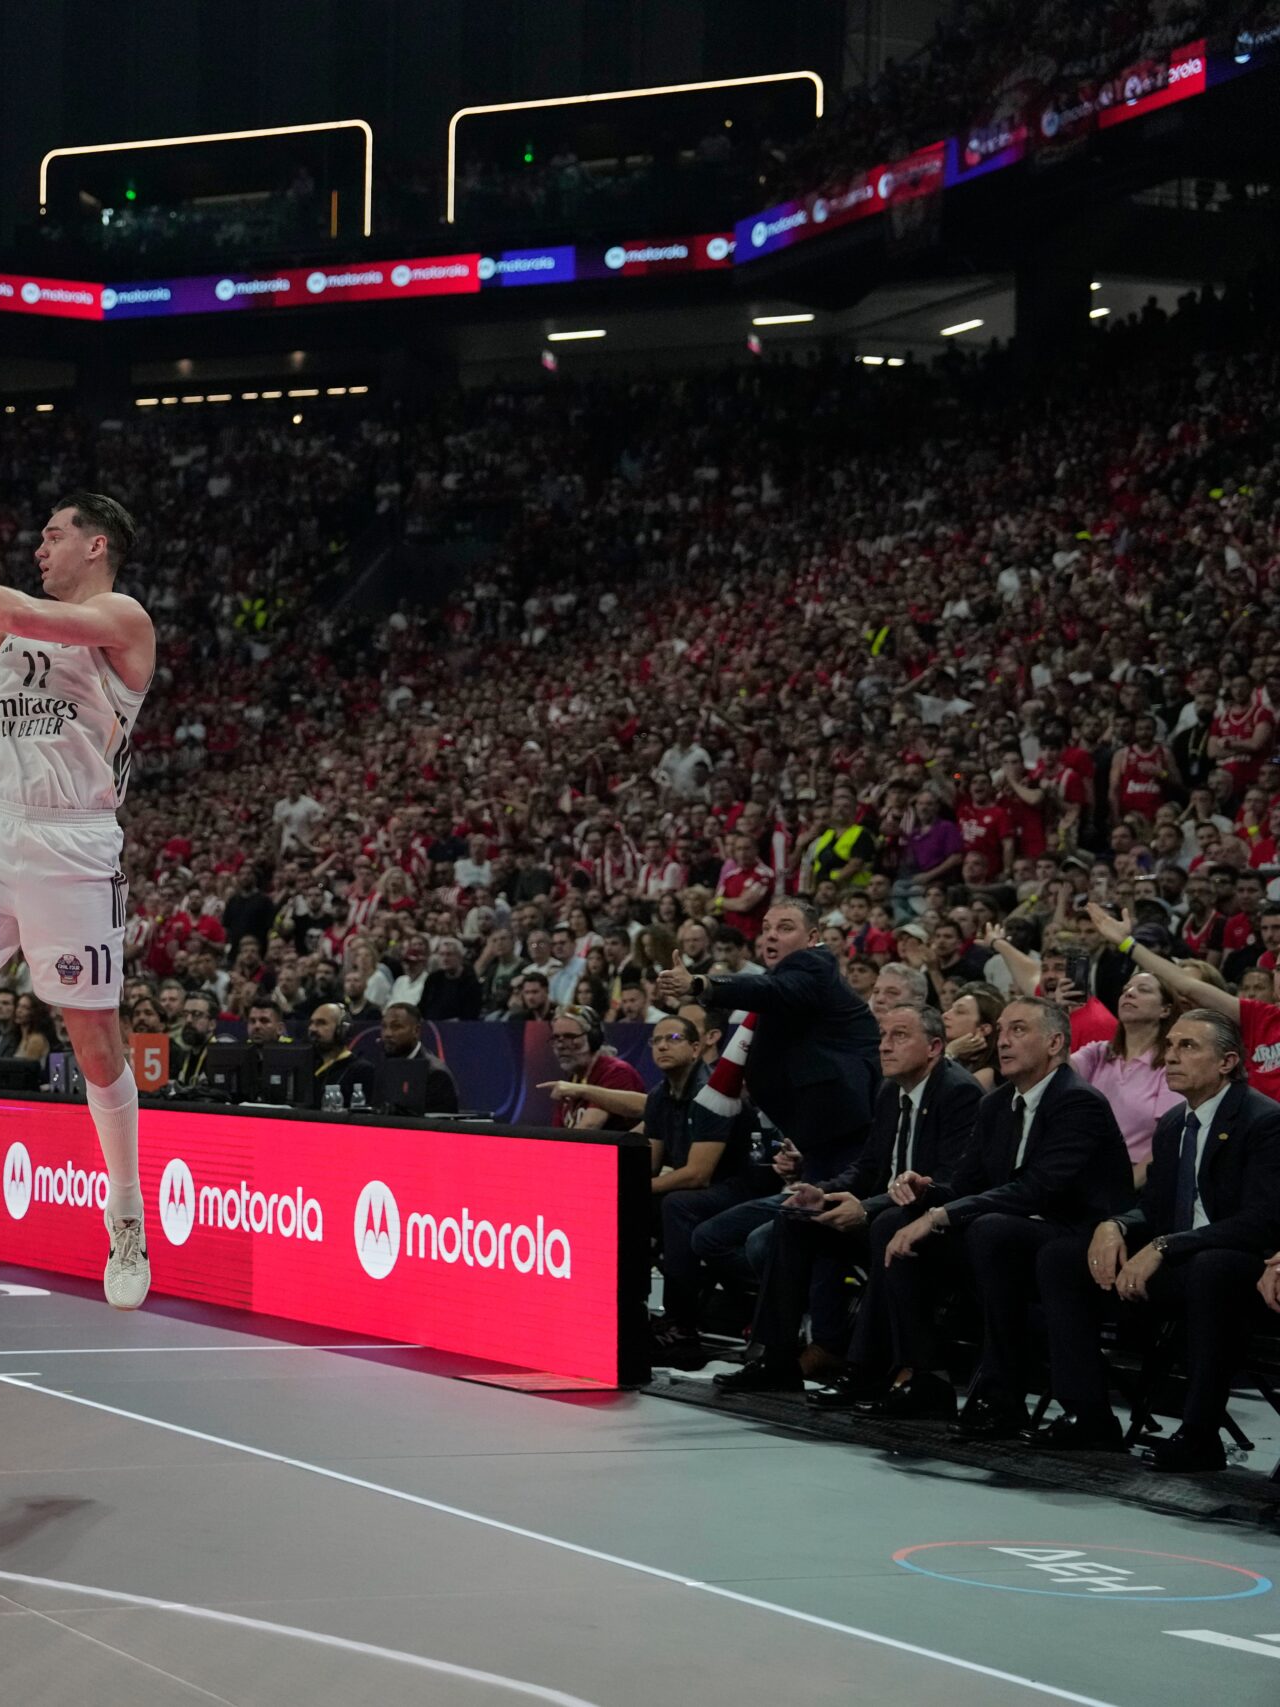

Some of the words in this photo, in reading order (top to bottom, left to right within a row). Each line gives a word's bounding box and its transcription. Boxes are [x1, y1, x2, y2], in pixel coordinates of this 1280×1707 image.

[625, 244, 688, 263] motorola
[410, 264, 469, 282] motorola
[496, 256, 555, 273] motorola
[235, 278, 290, 295] motorola
[326, 271, 384, 288] motorola
[40, 288, 94, 305] motorola
[117, 287, 171, 303] motorola
[18, 717, 64, 738] BETTER
[85, 944, 111, 986] 11
[144, 1048, 162, 1081] 5
[34, 1160, 110, 1210] motoro
[199, 1180, 323, 1242] motorola
[406, 1207, 571, 1279] motorola
